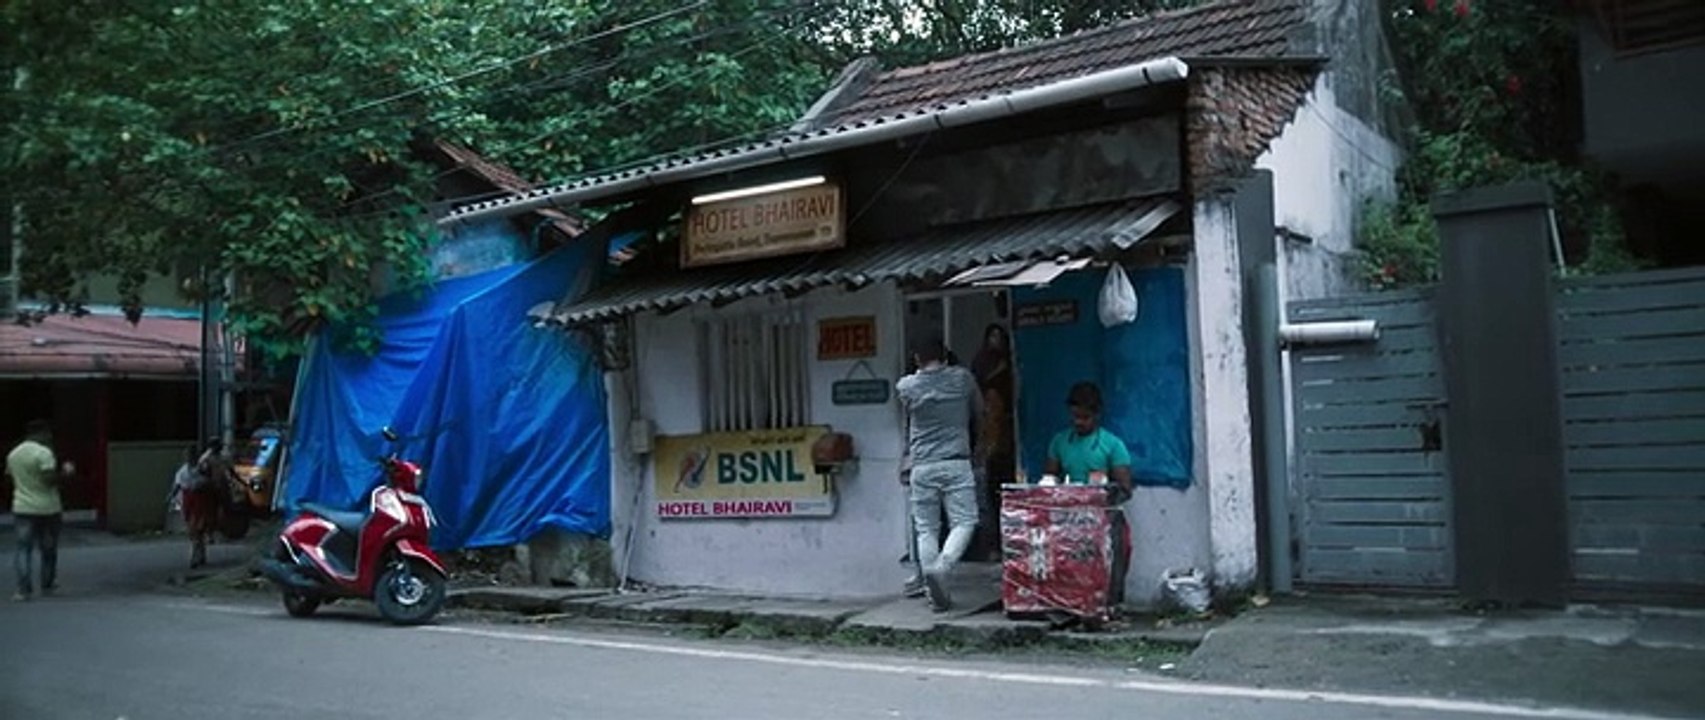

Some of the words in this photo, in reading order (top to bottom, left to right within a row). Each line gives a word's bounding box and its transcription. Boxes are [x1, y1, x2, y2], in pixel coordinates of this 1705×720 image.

[692, 206, 749, 235] HOTEL
[754, 193, 834, 226] BHAIRAVI
[819, 323, 875, 355] HOTEL
[717, 449, 804, 484] BSNL
[658, 502, 708, 515] HOTEL
[713, 501, 792, 514] BHAIRAVI
